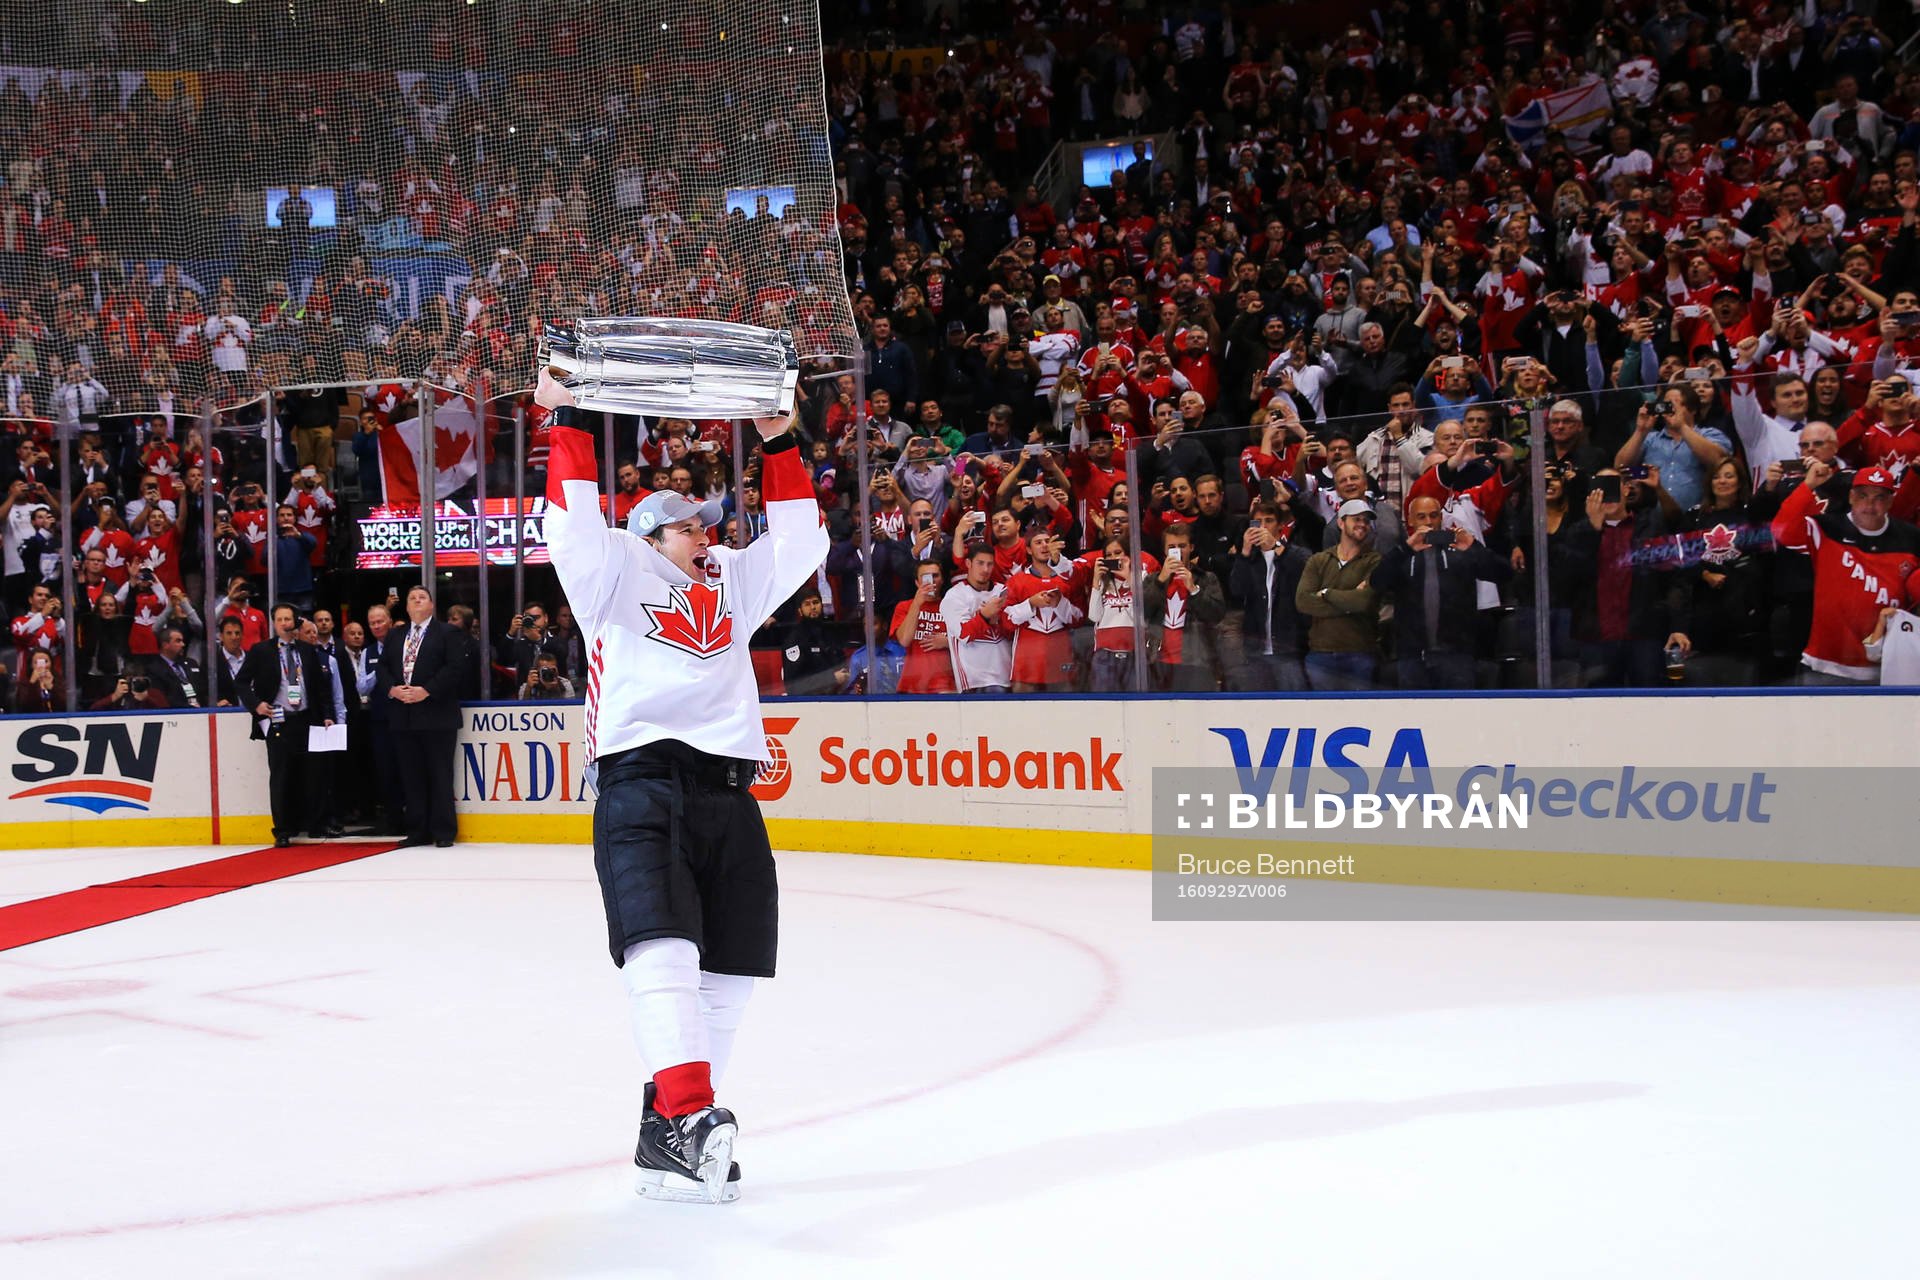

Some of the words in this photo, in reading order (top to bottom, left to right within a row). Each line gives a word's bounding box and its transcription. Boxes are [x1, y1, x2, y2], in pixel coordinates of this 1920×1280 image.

[360, 522, 421, 537] WORLD
[435, 521, 458, 534] UP
[363, 535, 421, 550] HOCKE
[434, 534, 470, 549] 2016
[476, 519, 547, 545] CHA
[472, 712, 565, 732] MOLSON
[11, 722, 164, 783] SN
[819, 732, 1125, 792] Scotiabank
[1208, 727, 1438, 809] VISA
[1455, 763, 1777, 824] Checkout
